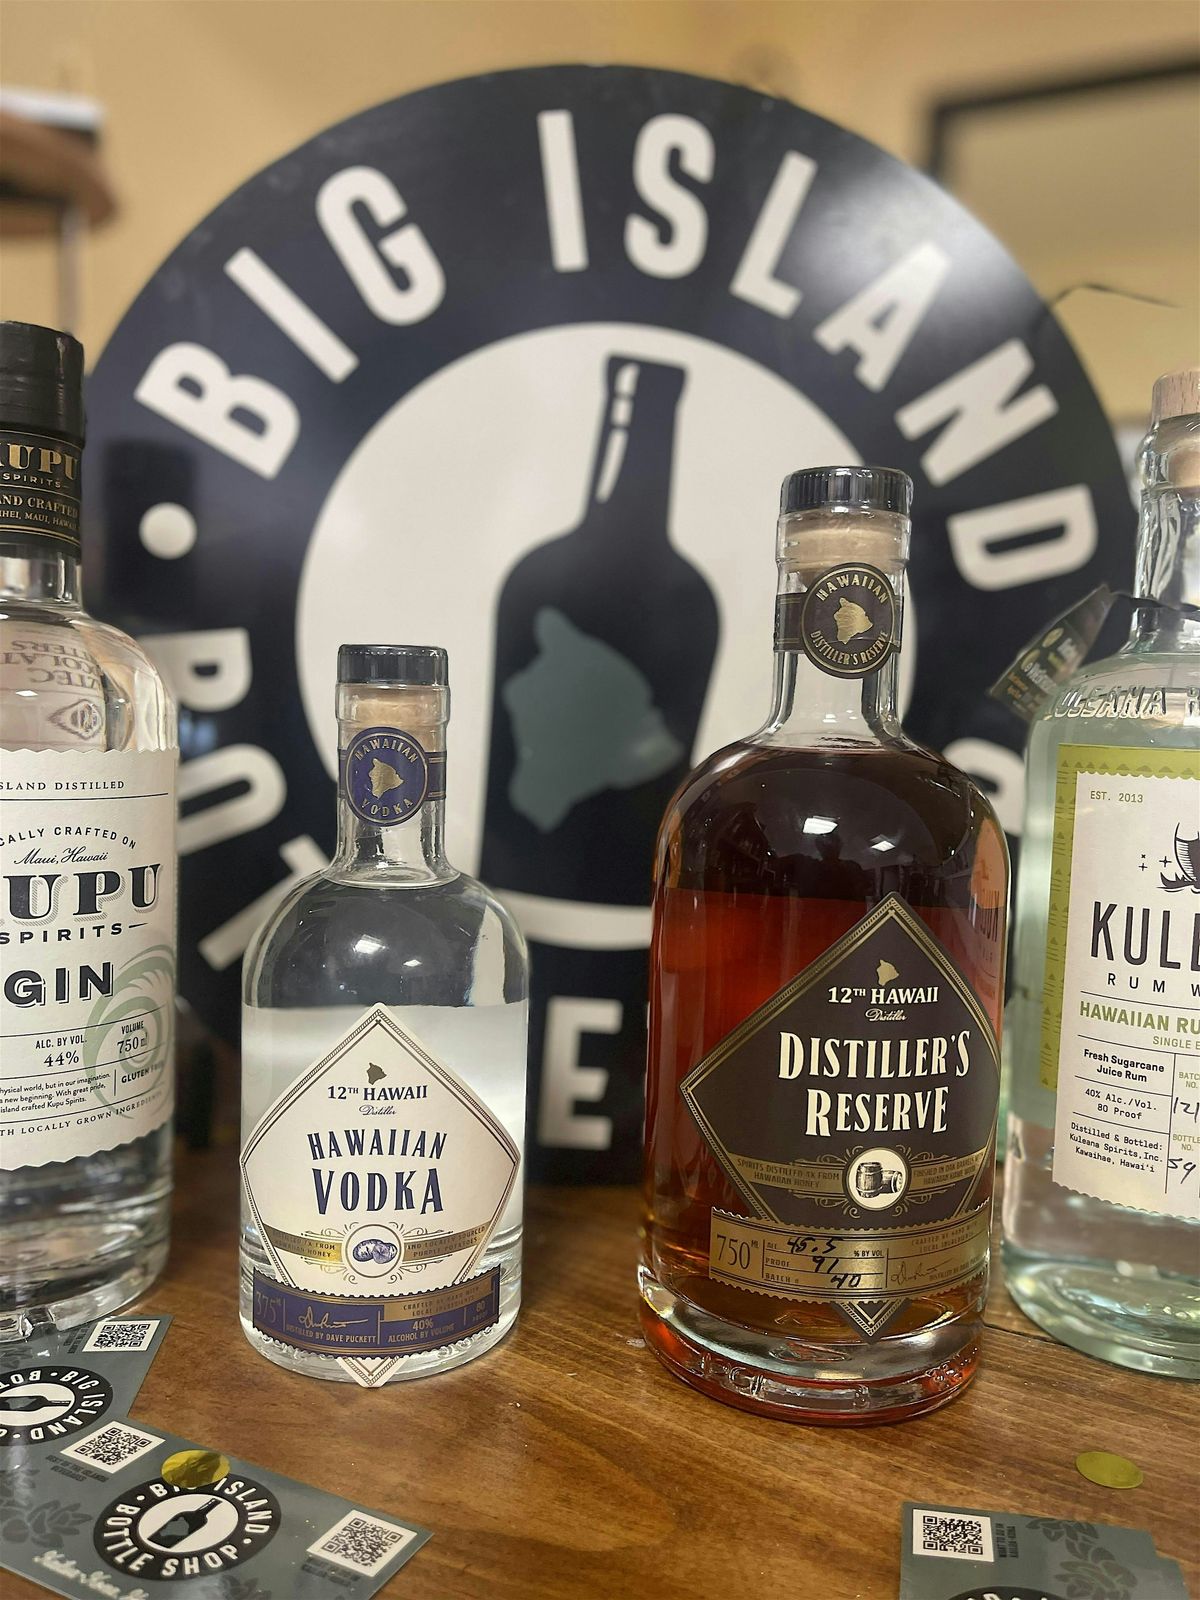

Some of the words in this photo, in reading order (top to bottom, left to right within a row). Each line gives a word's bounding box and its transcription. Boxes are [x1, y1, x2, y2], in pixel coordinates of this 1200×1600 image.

[134, 165, 446, 480] BIG
[537, 109, 1099, 592] ISLAND
[0, 443, 78, 480] UPU
[2, 473, 61, 488] SPIRITS
[0, 494, 23, 506] ND
[27, 497, 79, 518] CRAFTED
[815, 574, 889, 604] HAWAIIAN
[810, 630, 859, 666] DISTILLER'S
[859, 630, 889, 664] RESERVE
[354, 739, 418, 763] HAWAIIAN
[54, 781, 125, 790] DISTILLED
[1090, 791, 1112, 801] EST.
[1118, 793, 1144, 803] 2013
[361, 799, 413, 817] VODKA
[54, 826, 117, 840] CRAFTED
[122, 836, 136, 850] ON
[13, 847, 59, 865] Maui,
[60, 845, 109, 864] Hawaii
[0, 923, 122, 945] SPIRITS
[3, 961, 114, 1008] GIN
[1106, 971, 1167, 994] RUM
[827, 986, 866, 1004] 12TH
[870, 986, 939, 1005] HAWAII
[865, 1007, 907, 1022] Distiller
[1080, 1000, 1169, 1032] HAWAIIAN
[121, 1020, 145, 1035] VOLUME
[35, 1038, 54, 1050] ALC.
[56, 1037, 67, 1047] BY
[70, 1034, 88, 1046] VOL.
[1152, 1035, 1192, 1049] SINGLE
[43, 1049, 80, 1068] 44%
[778, 1030, 971, 1080] DISTILLER'S
[1083, 1048, 1109, 1063] Fresh
[1110, 1055, 1165, 1073] Sugarcane
[121, 1066, 150, 1083] GLUTEN
[1096, 1064, 1123, 1078] Juice
[1125, 1070, 1148, 1083] Rum
[24, 1083, 44, 1091] world,
[45, 1082, 56, 1090] but
[57, 1080, 64, 1088] in
[65, 1079, 76, 1087] our
[55, 1088, 71, 1097] With
[72, 1086, 89, 1097] great
[327, 1085, 359, 1100] 12TH
[363, 1084, 428, 1101] HAWAII
[1085, 1087, 1101, 1099] 40%
[1185, 1080, 1198, 1089] NO.
[0, 1105, 20, 1114] island
[21, 1102, 46, 1112] crafted
[47, 1100, 65, 1109] Kupu
[358, 1103, 397, 1116] Distiller
[805, 1086, 949, 1137] RESERVE
[1097, 1103, 1109, 1113] 80
[1113, 1106, 1143, 1120] Proof
[21, 1120, 71, 1135] LOCALLY
[76, 1111, 112, 1125] GROWN
[307, 1128, 448, 1161] HAWAIIAN
[1069, 1133, 1100, 1150] Kuleana
[1071, 1121, 1110, 1141] Distilled
[1113, 1133, 1120, 1142] &
[1123, 1135, 1163, 1151] Bottled:
[1075, 1146, 1115, 1165] Kawaihae,
[1181, 1143, 1194, 1152] NO.
[737, 1158, 764, 1171] SPIRITS
[766, 1165, 803, 1177] DISTILLED
[818, 1171, 840, 1181] FROM
[311, 1167, 444, 1215] VODKA
[315, 1241, 335, 1251] FROM
[406, 1240, 421, 1251] AND
[861, 1250, 870, 1258] BY
[872, 1250, 883, 1258] VOL
[766, 1256, 790, 1268] PROOF
[812, 1255, 839, 1275] 91
[766, 1271, 791, 1283] BATCH
[831, 1272, 861, 1289] 40
[412, 1319, 434, 1331] 40%
[316, 1331, 324, 1340] BY
[326, 1332, 344, 1343] DAVE
[345, 1334, 376, 1344] PUCKETT
[388, 1331, 418, 1343] ALCOHOL
[420, 1330, 429, 1339] BY
[60, 1370, 100, 1390] BIG
[30, 1393, 106, 1440] ISLAND
[213, 1477, 273, 1535] ISLAND
[103, 1503, 155, 1572] BOTTLE
[160, 1543, 239, 1577] SHOP
